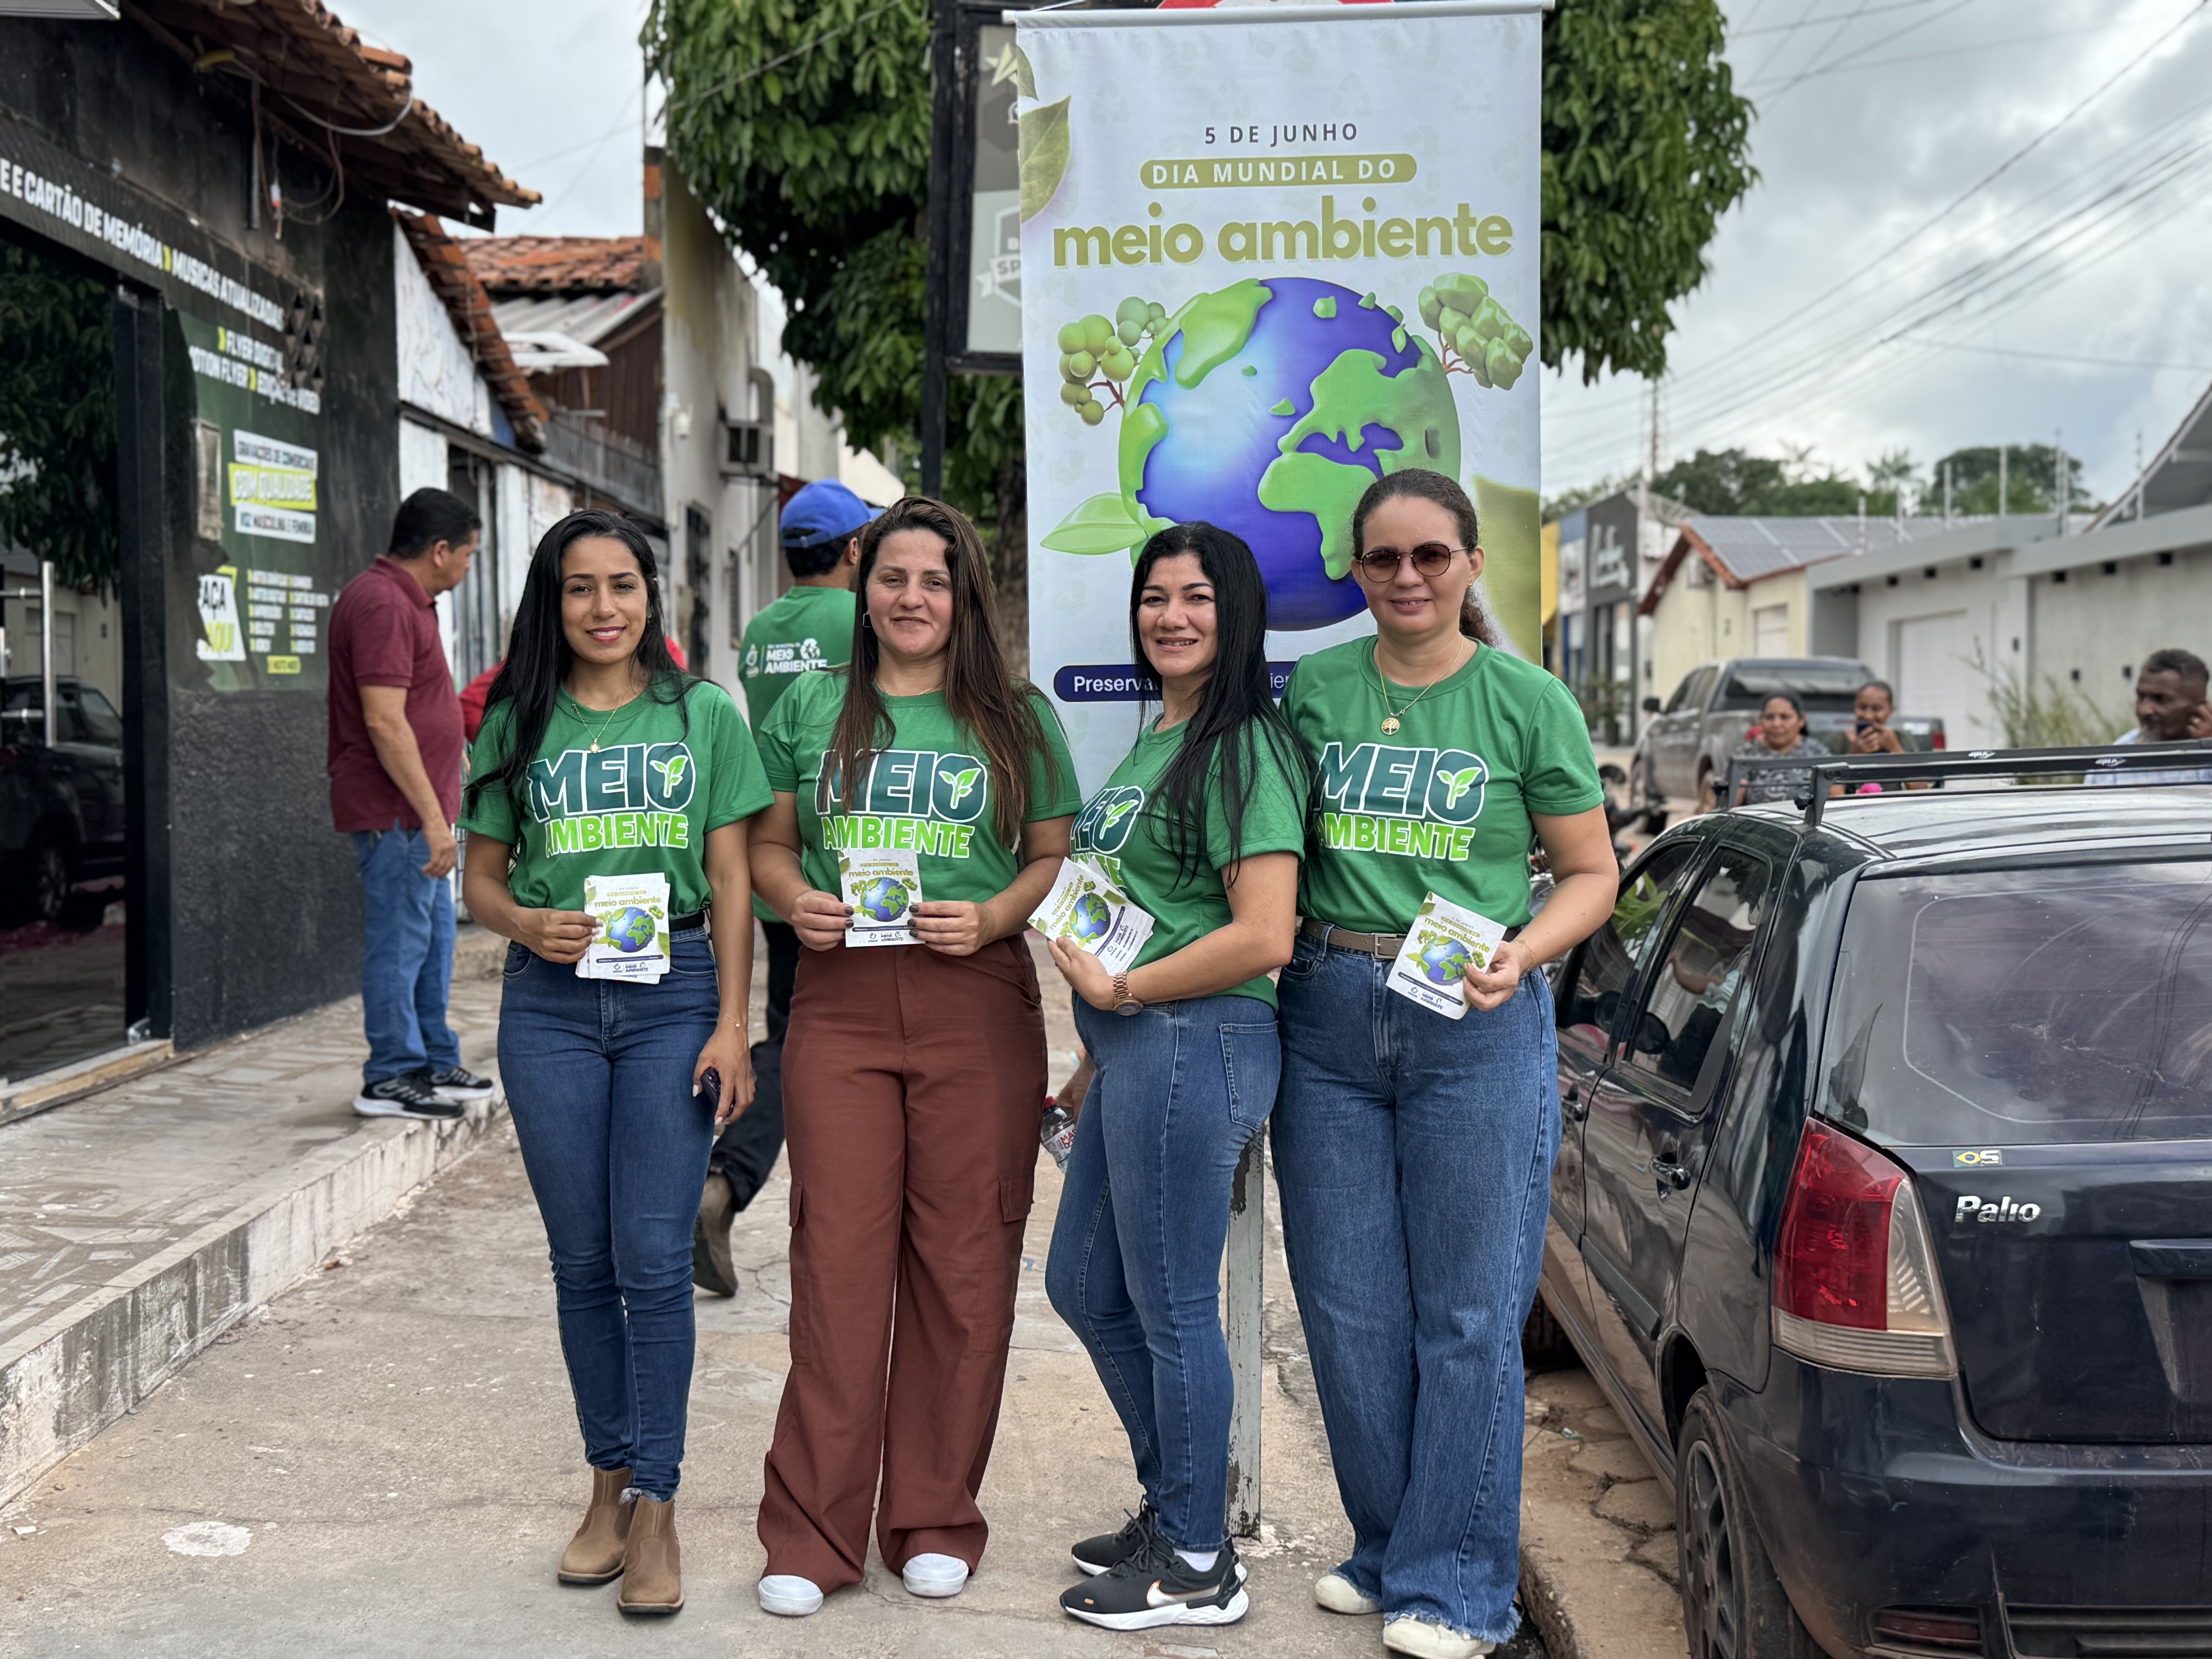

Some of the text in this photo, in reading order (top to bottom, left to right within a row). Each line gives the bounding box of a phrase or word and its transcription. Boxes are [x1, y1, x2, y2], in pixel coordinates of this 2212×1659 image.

[1205, 123, 1358, 147] 5 DE JUNHO
[1152, 158, 1396, 184] DIA MUNDIAL DO
[12, 163, 23, 199] E
[24, 170, 82, 228] CARTÃO
[84, 201, 102, 239] DE
[103, 211, 163, 270] MEMÓRIA
[1053, 194, 1513, 266] meio ambiente
[221, 356, 248, 389] FLYER
[198, 577, 225, 620] AÇA
[764, 647, 794, 661] MEIO
[764, 658, 827, 674] AMBIENTE
[527, 742, 696, 823] MEIO
[815, 749, 987, 823] MEIO
[1311, 742, 1489, 825] MEIO
[821, 815, 975, 859] AMBIENTE
[1955, 1195, 2041, 1222] Palio
